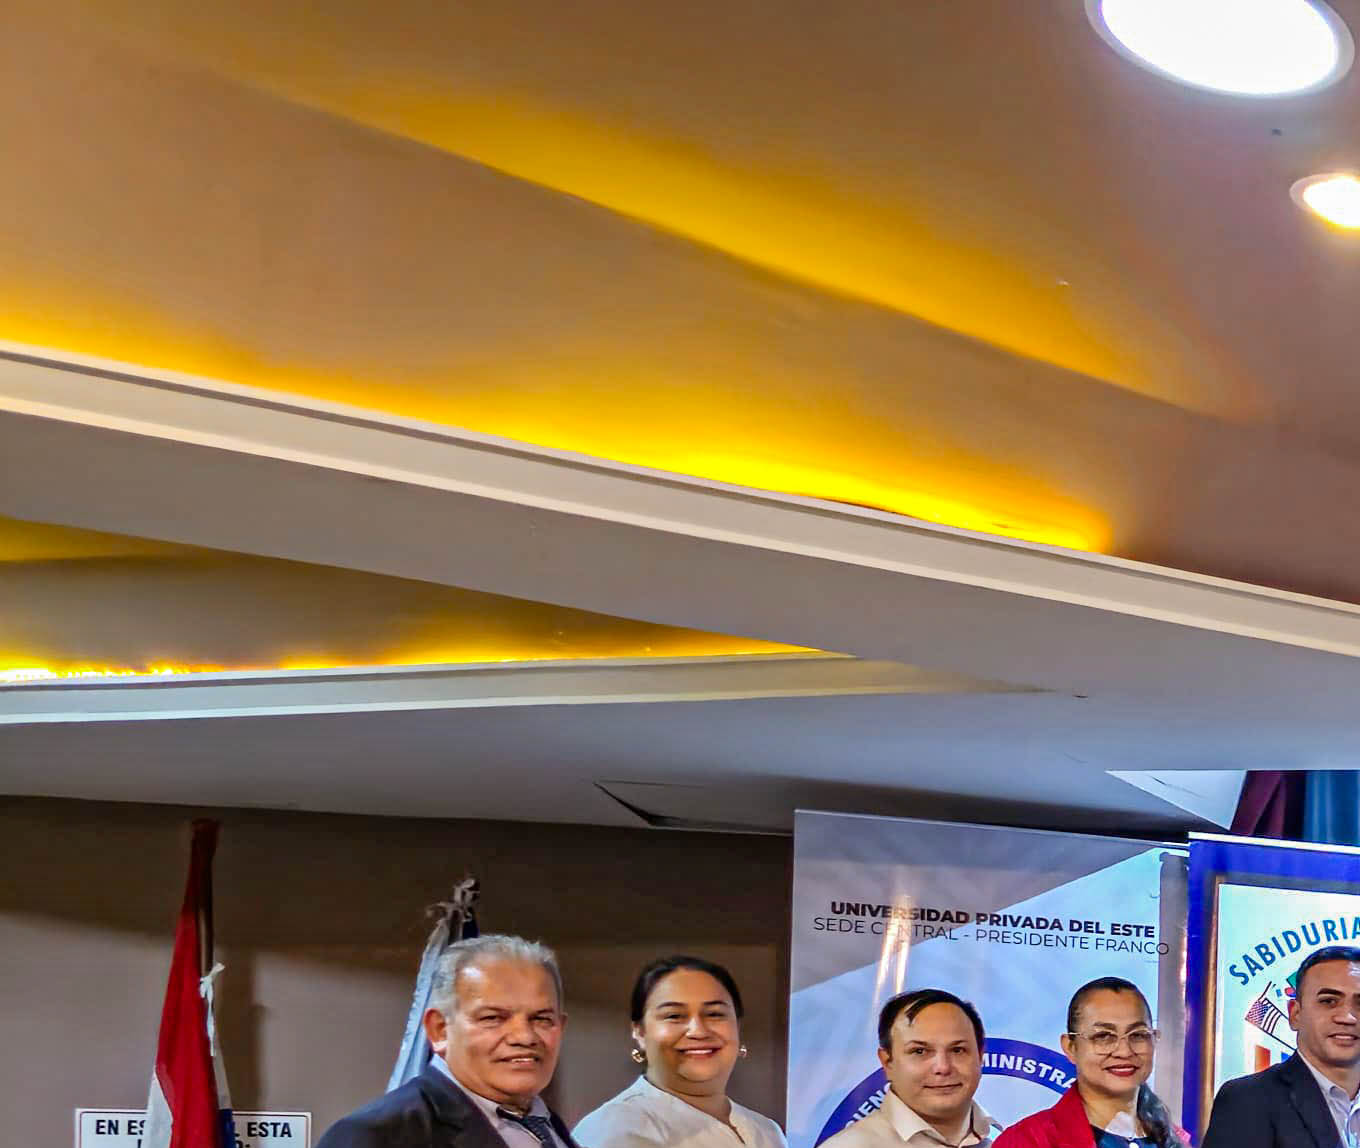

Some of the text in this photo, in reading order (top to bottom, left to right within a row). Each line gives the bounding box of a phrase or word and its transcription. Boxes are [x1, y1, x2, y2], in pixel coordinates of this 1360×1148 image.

[813, 916, 865, 935] SEDE
[976, 929, 1090, 951] PRESIDENTE
[1095, 938, 1170, 956] FRANCO
[831, 900, 1156, 939] UNIVERSIDAD PRIVADA DEL ESTE
[95, 1119, 119, 1136] EN
[247, 1121, 293, 1138] ESTA
